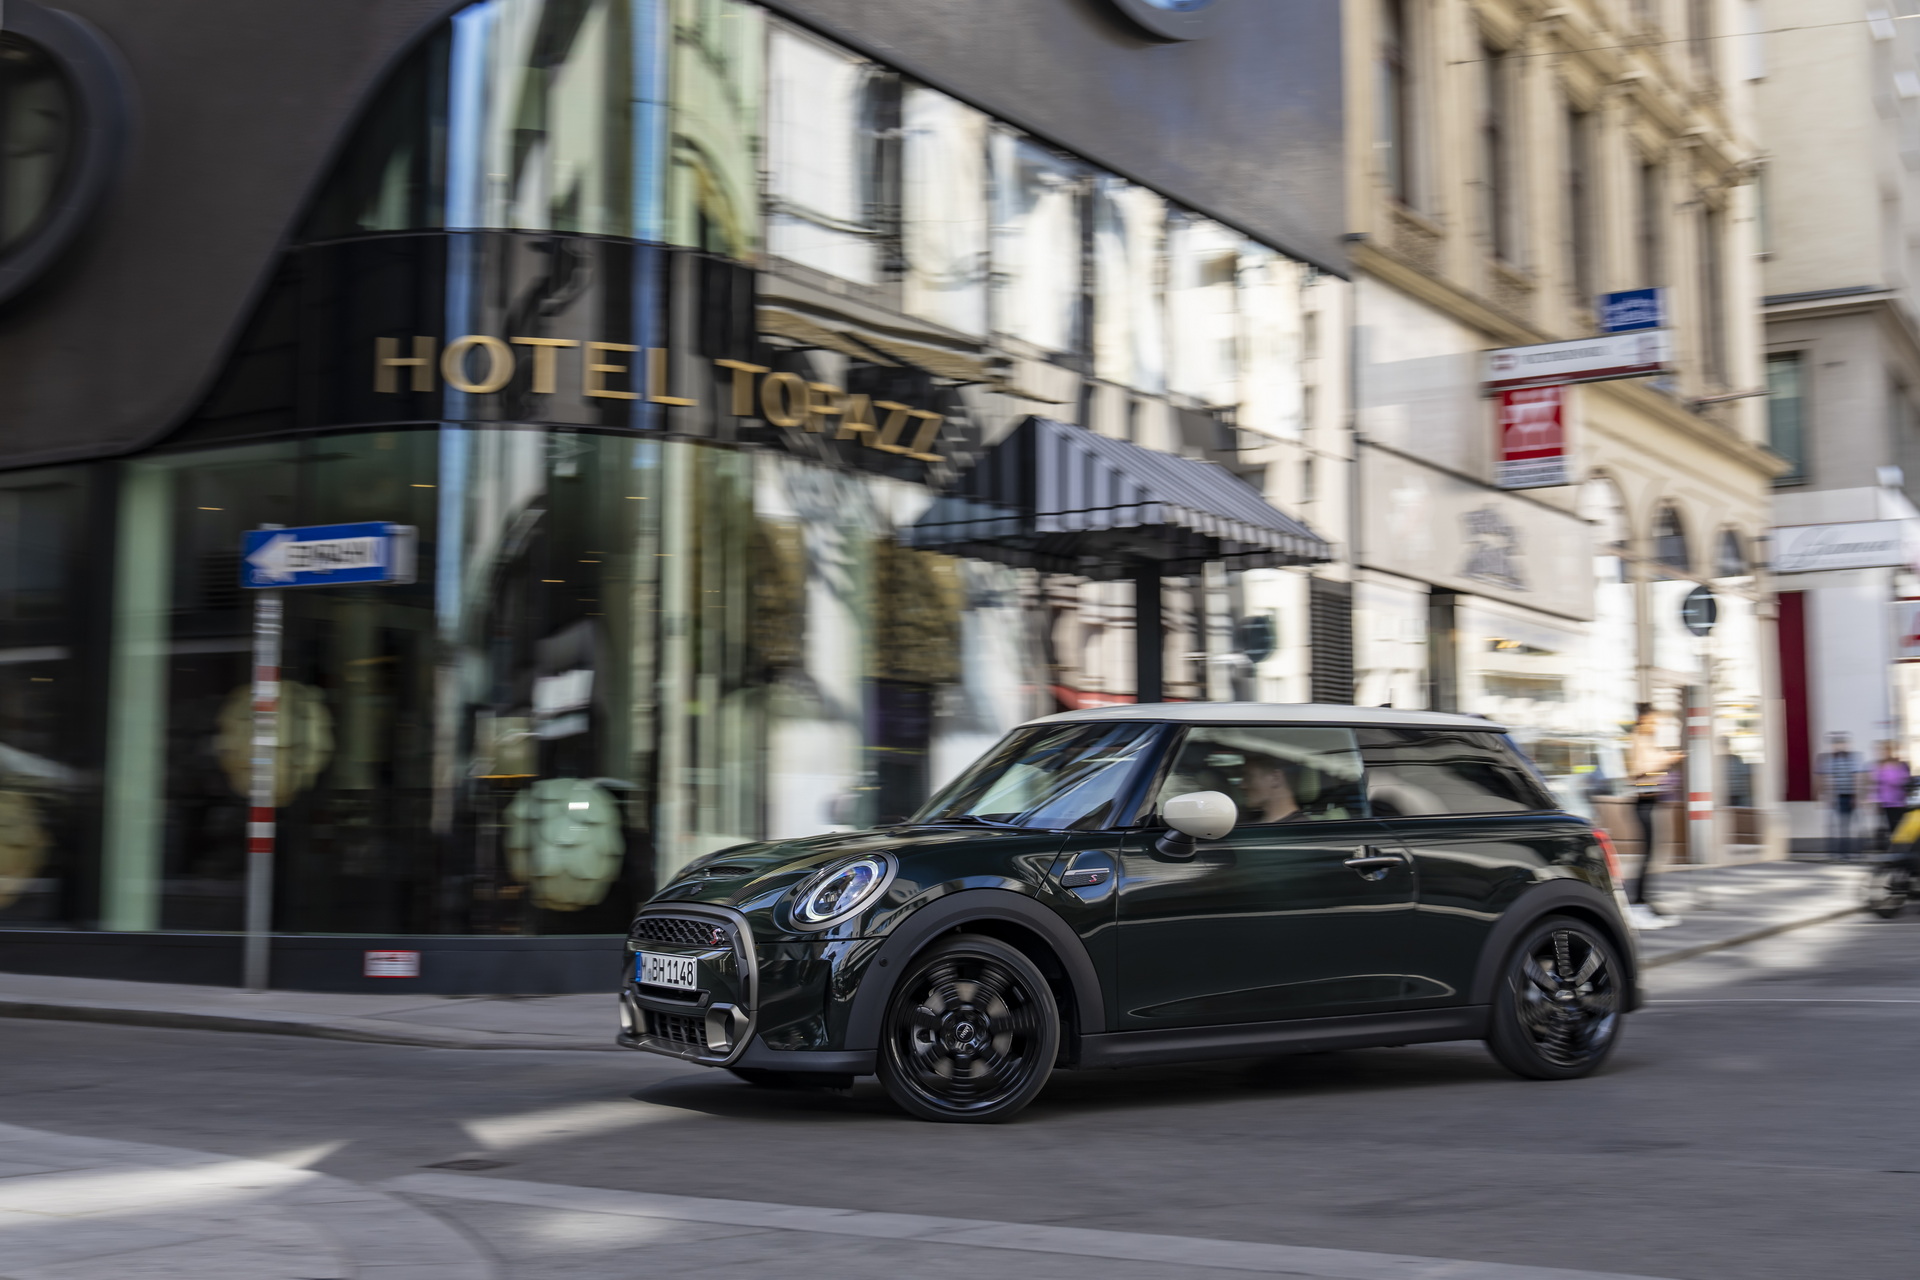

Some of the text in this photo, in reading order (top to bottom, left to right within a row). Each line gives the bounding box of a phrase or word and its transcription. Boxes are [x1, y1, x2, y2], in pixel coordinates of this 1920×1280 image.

[373, 334, 946, 462] HOTEL TOPAZZ
[652, 957, 665, 983] BH
[667, 959, 694, 986] 1148
